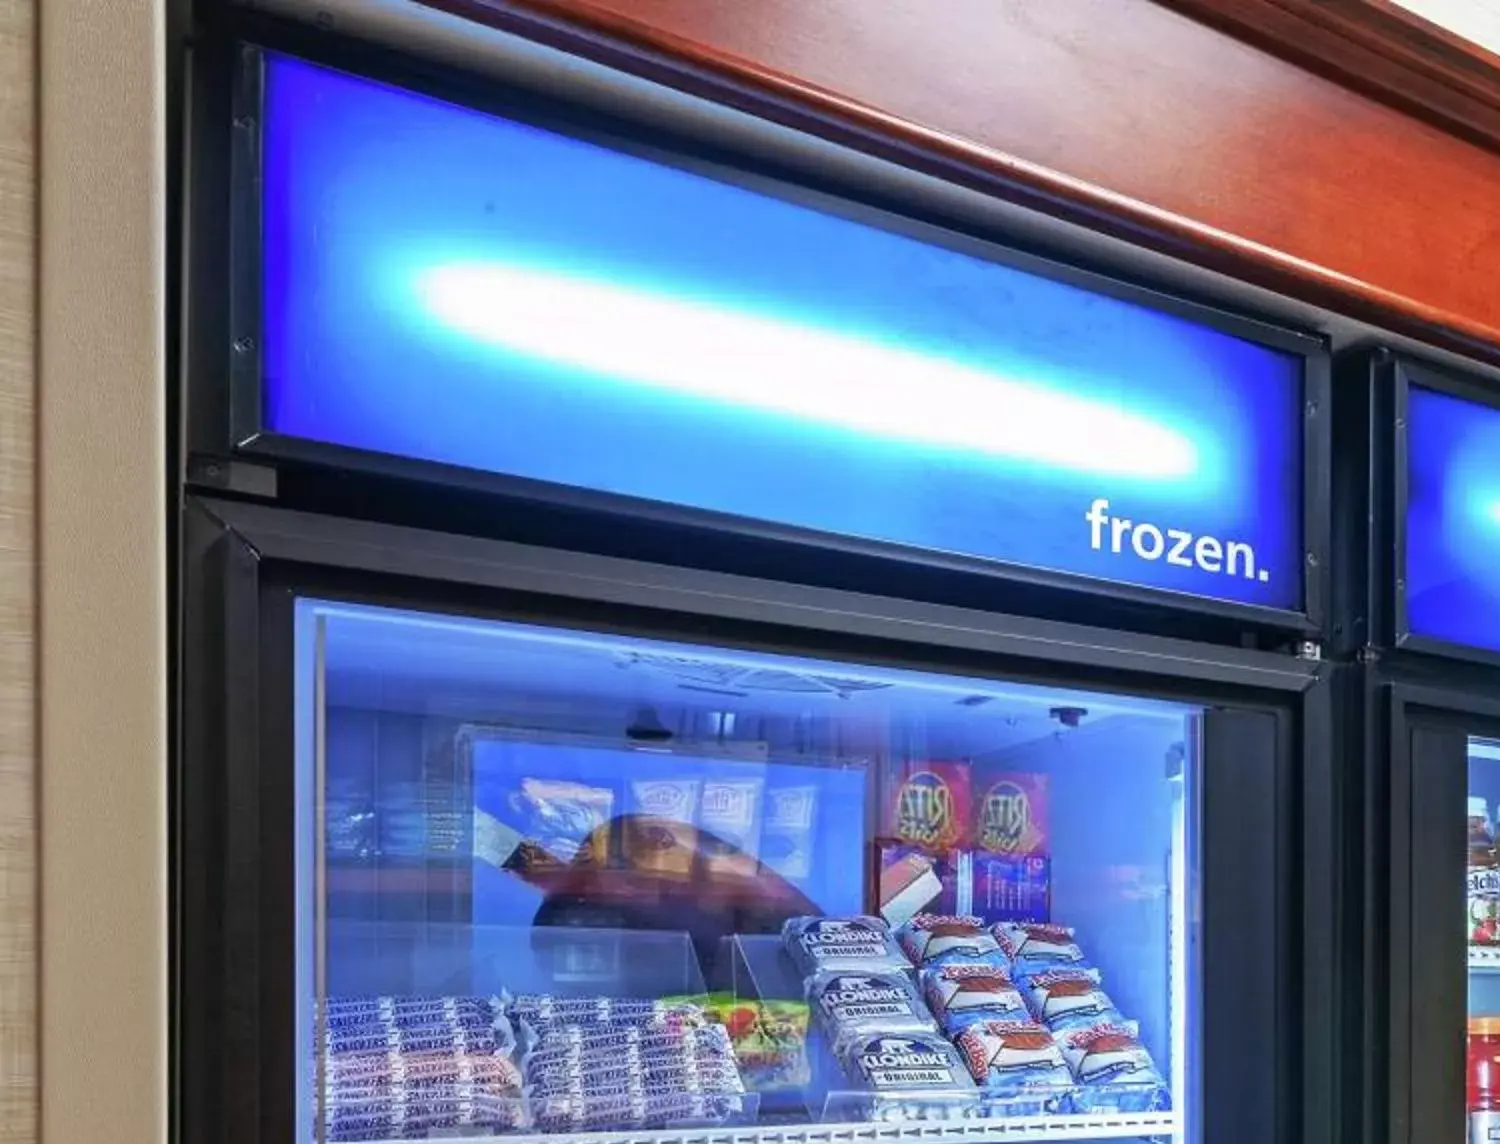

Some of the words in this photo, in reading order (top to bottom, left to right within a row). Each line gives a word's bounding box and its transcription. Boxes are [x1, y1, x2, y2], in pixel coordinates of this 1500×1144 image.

[1085, 498, 1269, 583] frozen.
[801, 931, 883, 946] KLONDIKE
[820, 988, 912, 1008] KLONDIKE
[845, 1005, 902, 1017] ORIGINAL
[862, 1052, 951, 1070] KLONDIKE
[883, 1071, 944, 1082] ORIGINAL
